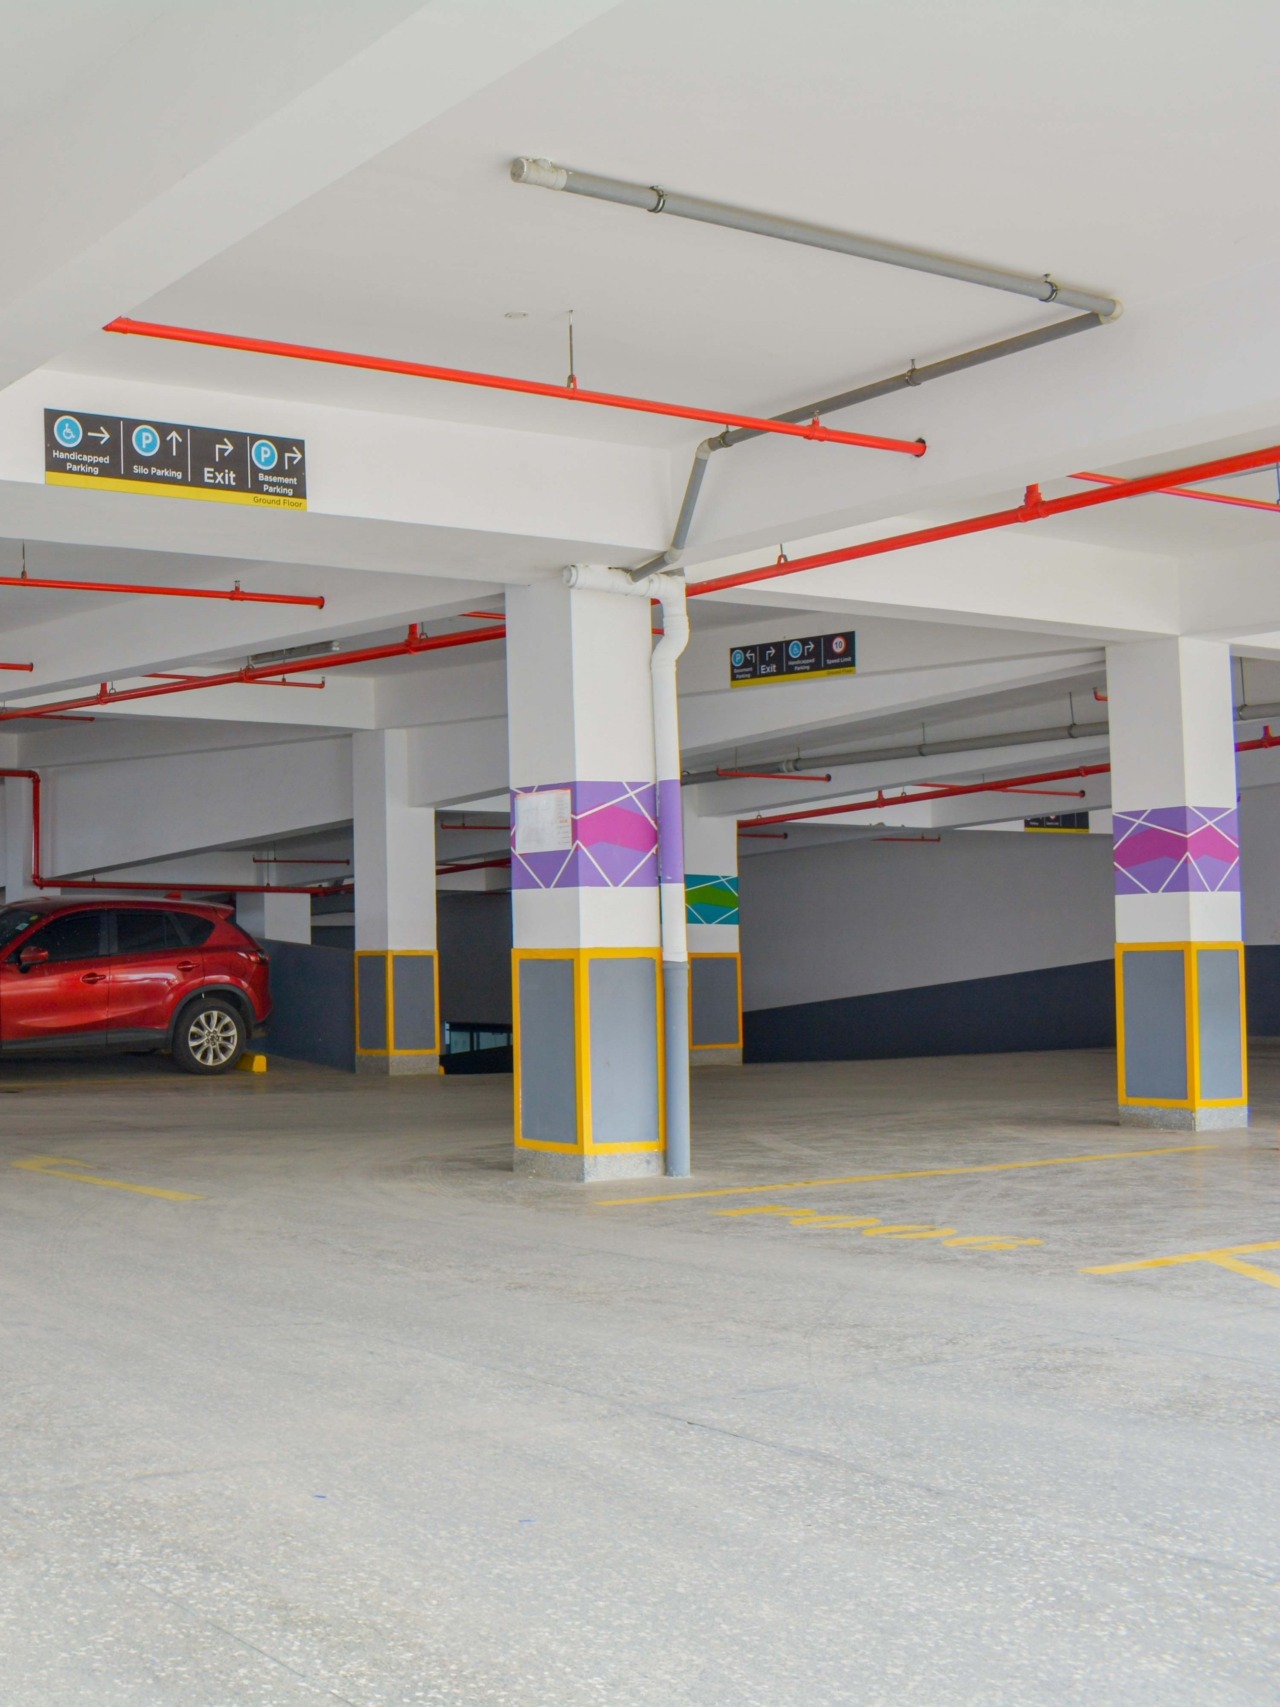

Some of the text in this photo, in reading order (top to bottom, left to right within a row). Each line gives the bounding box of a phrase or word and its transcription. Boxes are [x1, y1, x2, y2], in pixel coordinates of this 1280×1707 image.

[142, 432, 153, 449] P
[52, 449, 110, 464] Handicapped
[261, 446, 271, 463] P
[66, 462, 99, 475] Parking
[132, 464, 182, 479] Silo Parking
[204, 467, 236, 485] Exit
[258, 473, 298, 485] Basement
[263, 484, 293, 496] Parking
[253, 496, 303, 508] Ground Floor
[834, 640, 843, 649] 10
[760, 664, 777, 674] Exit
